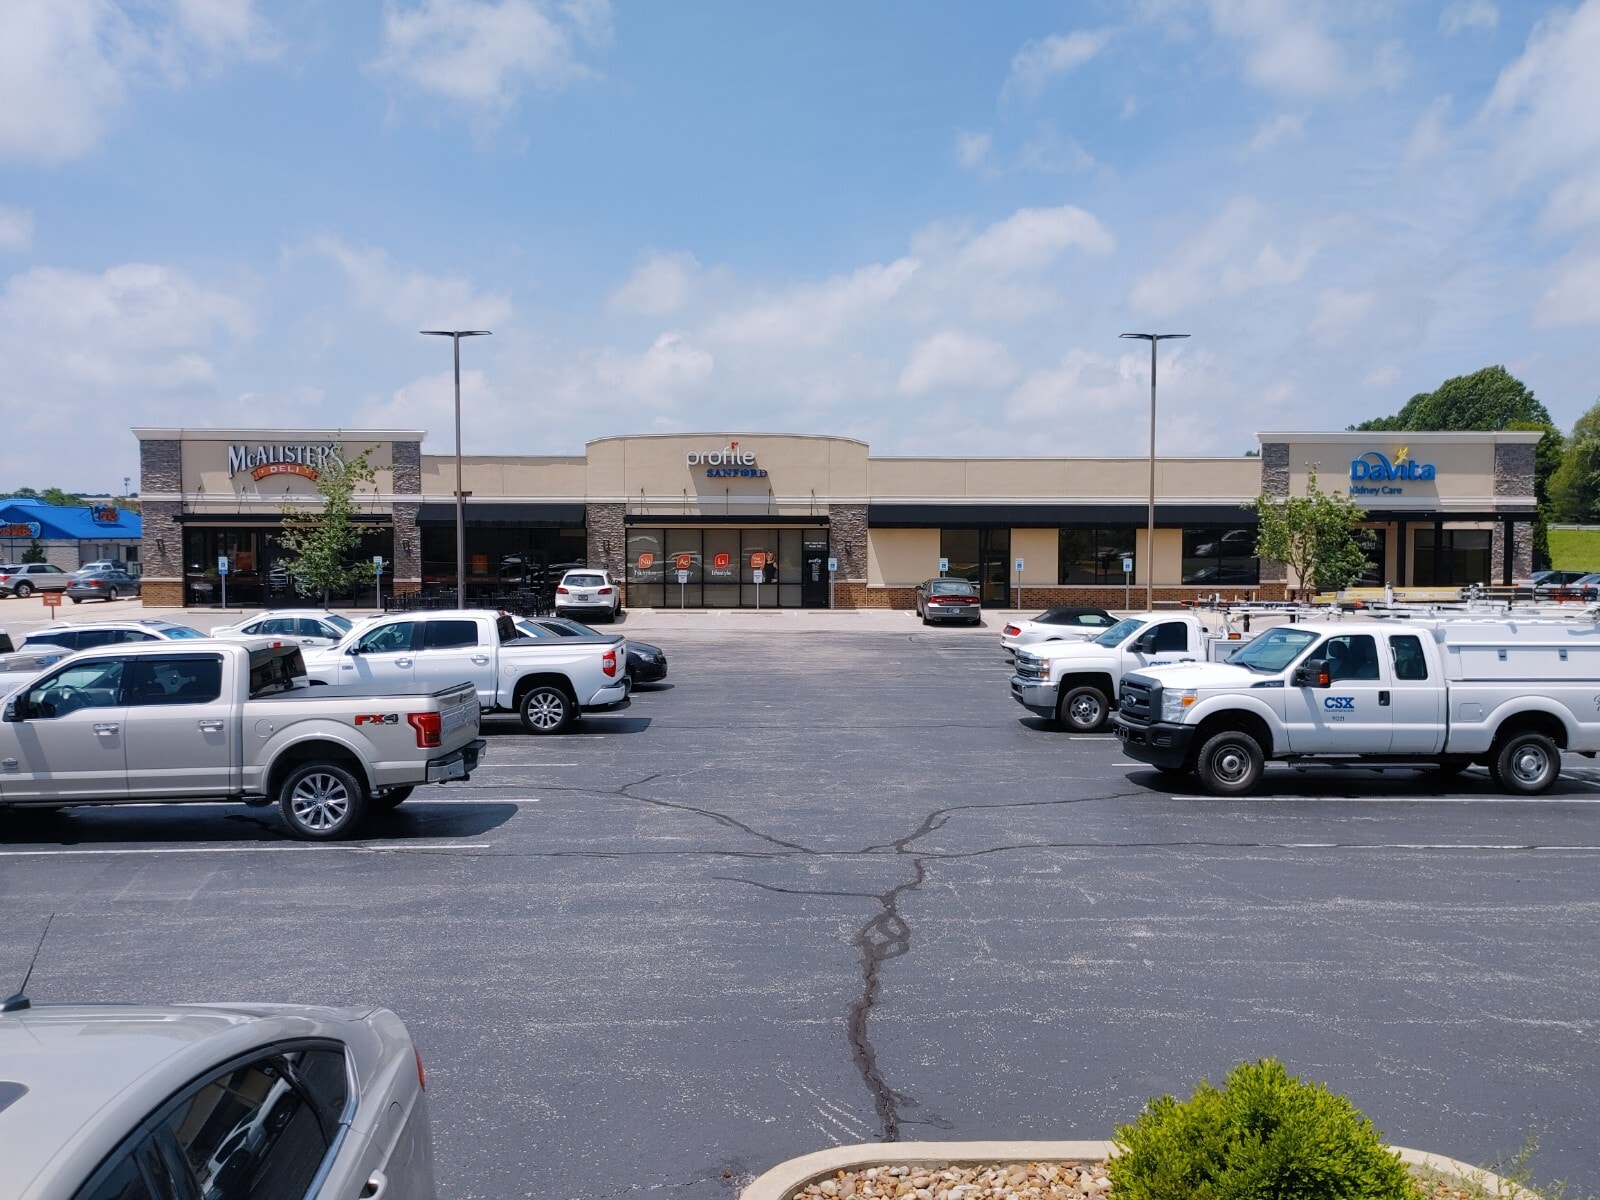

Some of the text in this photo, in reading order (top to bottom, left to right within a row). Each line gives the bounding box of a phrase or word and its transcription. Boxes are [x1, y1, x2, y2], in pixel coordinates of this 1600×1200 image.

[686, 446, 756, 469] profile
[269, 466, 300, 474] DELI
[1350, 452, 1436, 481] DaVita
[706, 468, 768, 478] SANFORD
[1350, 485, 1402, 496] Kidney Care
[1324, 697, 1354, 708] CSX
[354, 713, 399, 726] FX4
